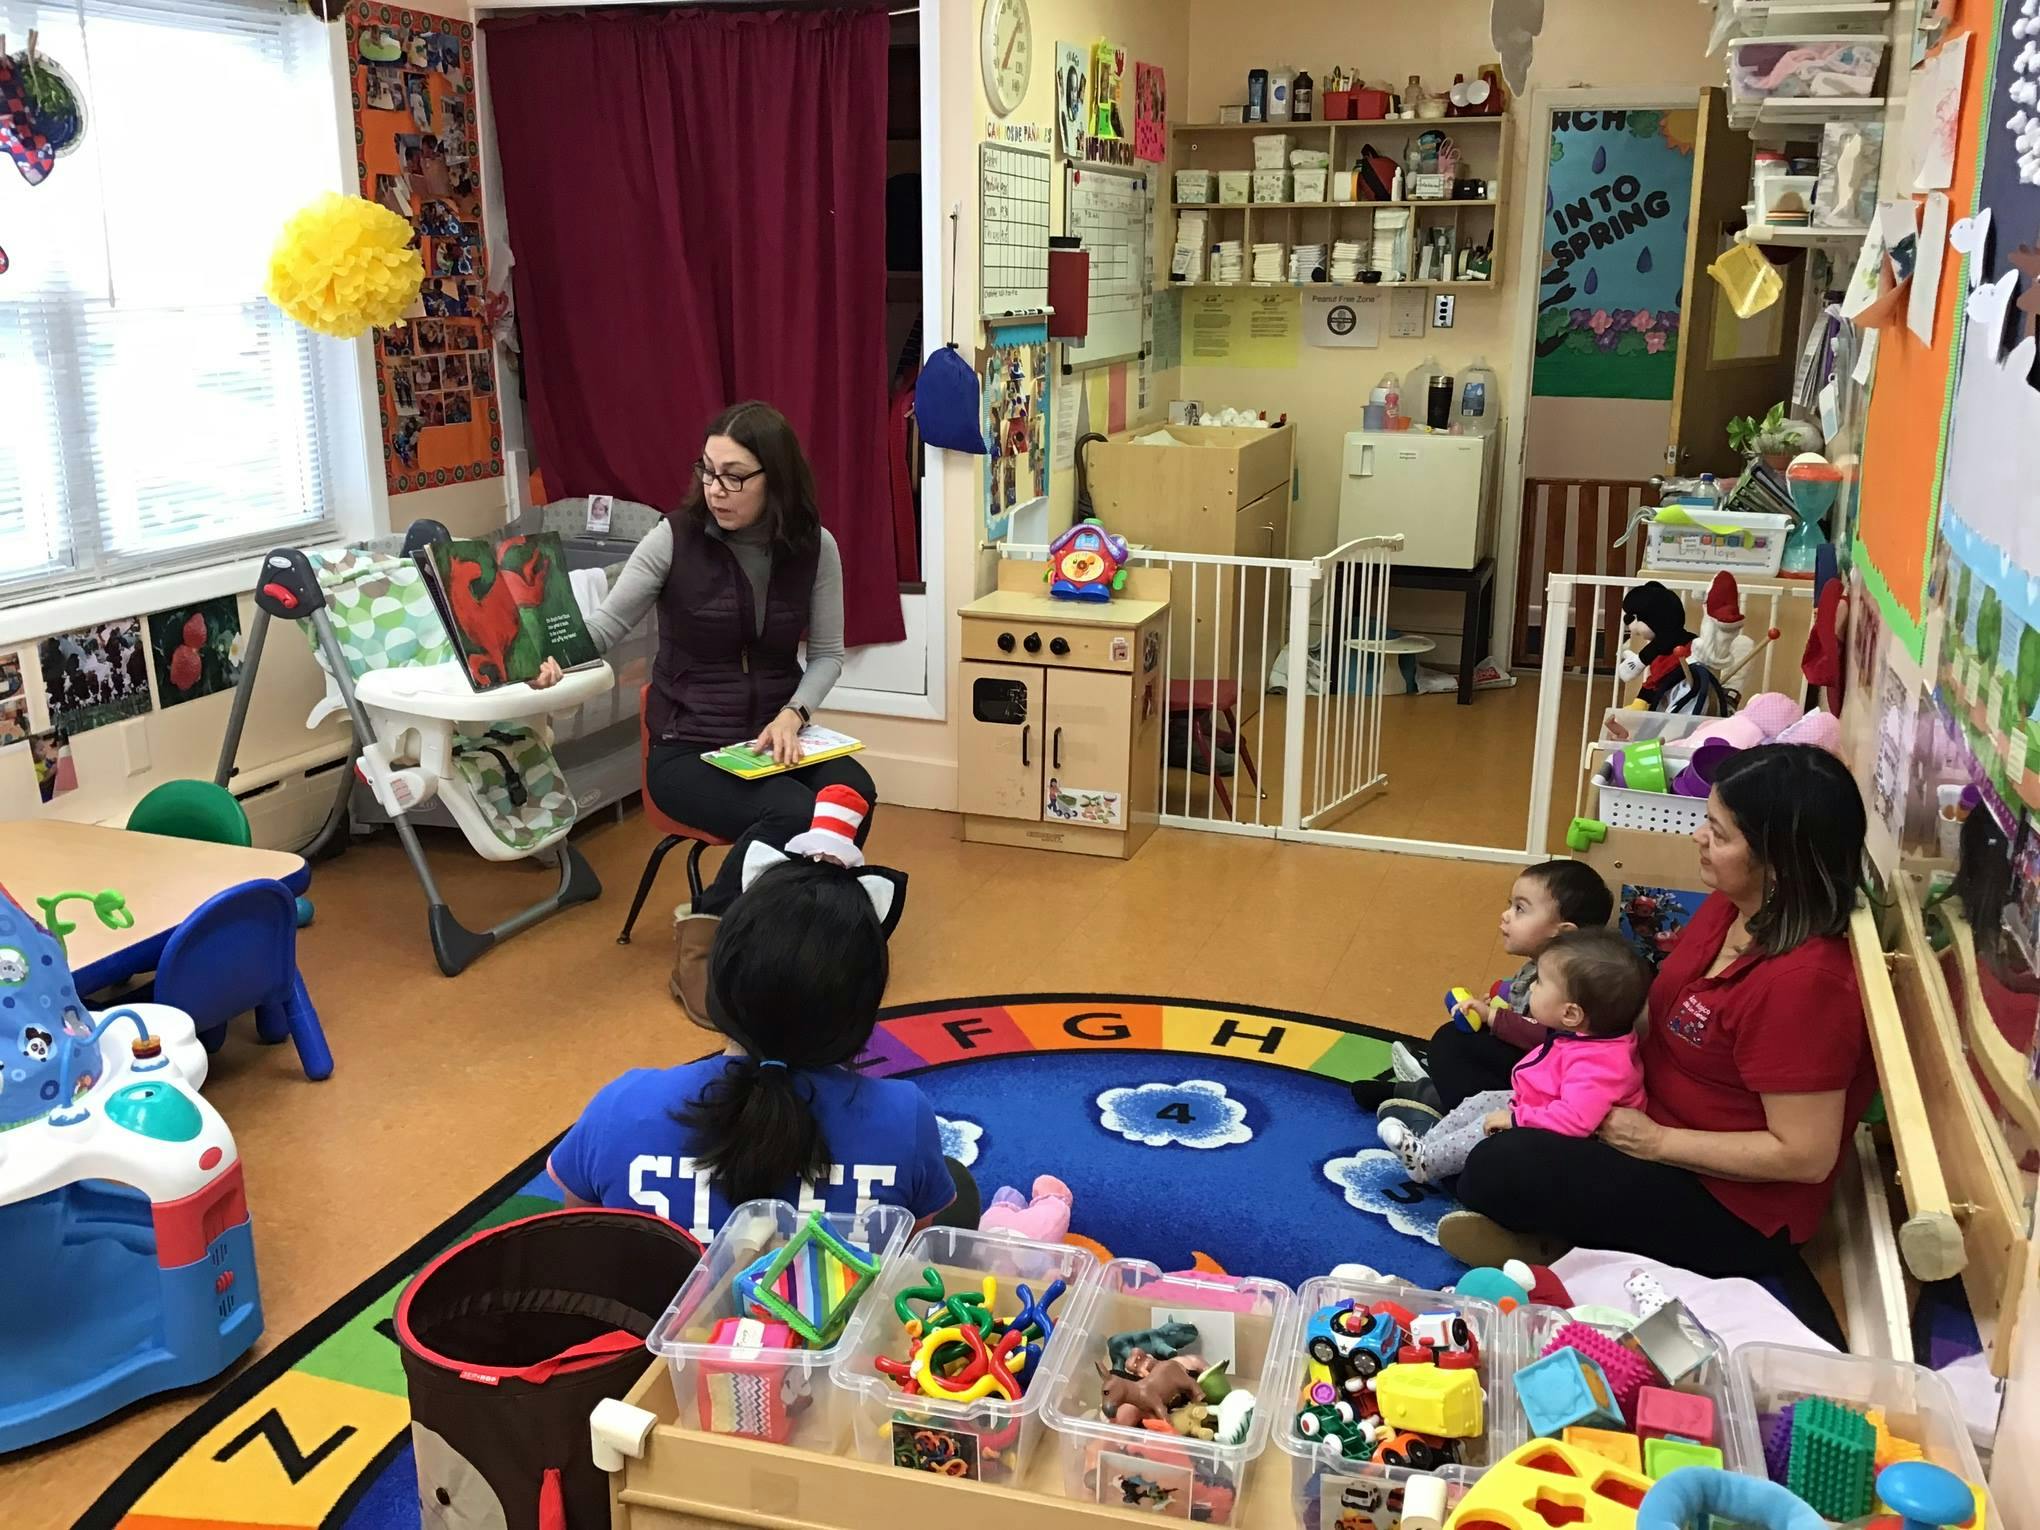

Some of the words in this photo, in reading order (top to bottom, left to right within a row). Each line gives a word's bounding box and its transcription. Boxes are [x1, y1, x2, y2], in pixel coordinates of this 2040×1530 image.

[1552, 175, 1641, 235] INTO
[1551, 190, 1671, 268] SPRING
[1312, 295, 1337, 303] Peanut
[1339, 295, 1355, 303] Free
[1356, 295, 1375, 303] Zone
[943, 1018, 992, 1049] F
[1063, 1012, 1131, 1041] G
[1211, 1020, 1286, 1054] H
[1156, 1103, 1196, 1125] 4
[628, 1154, 897, 1252] STFF
